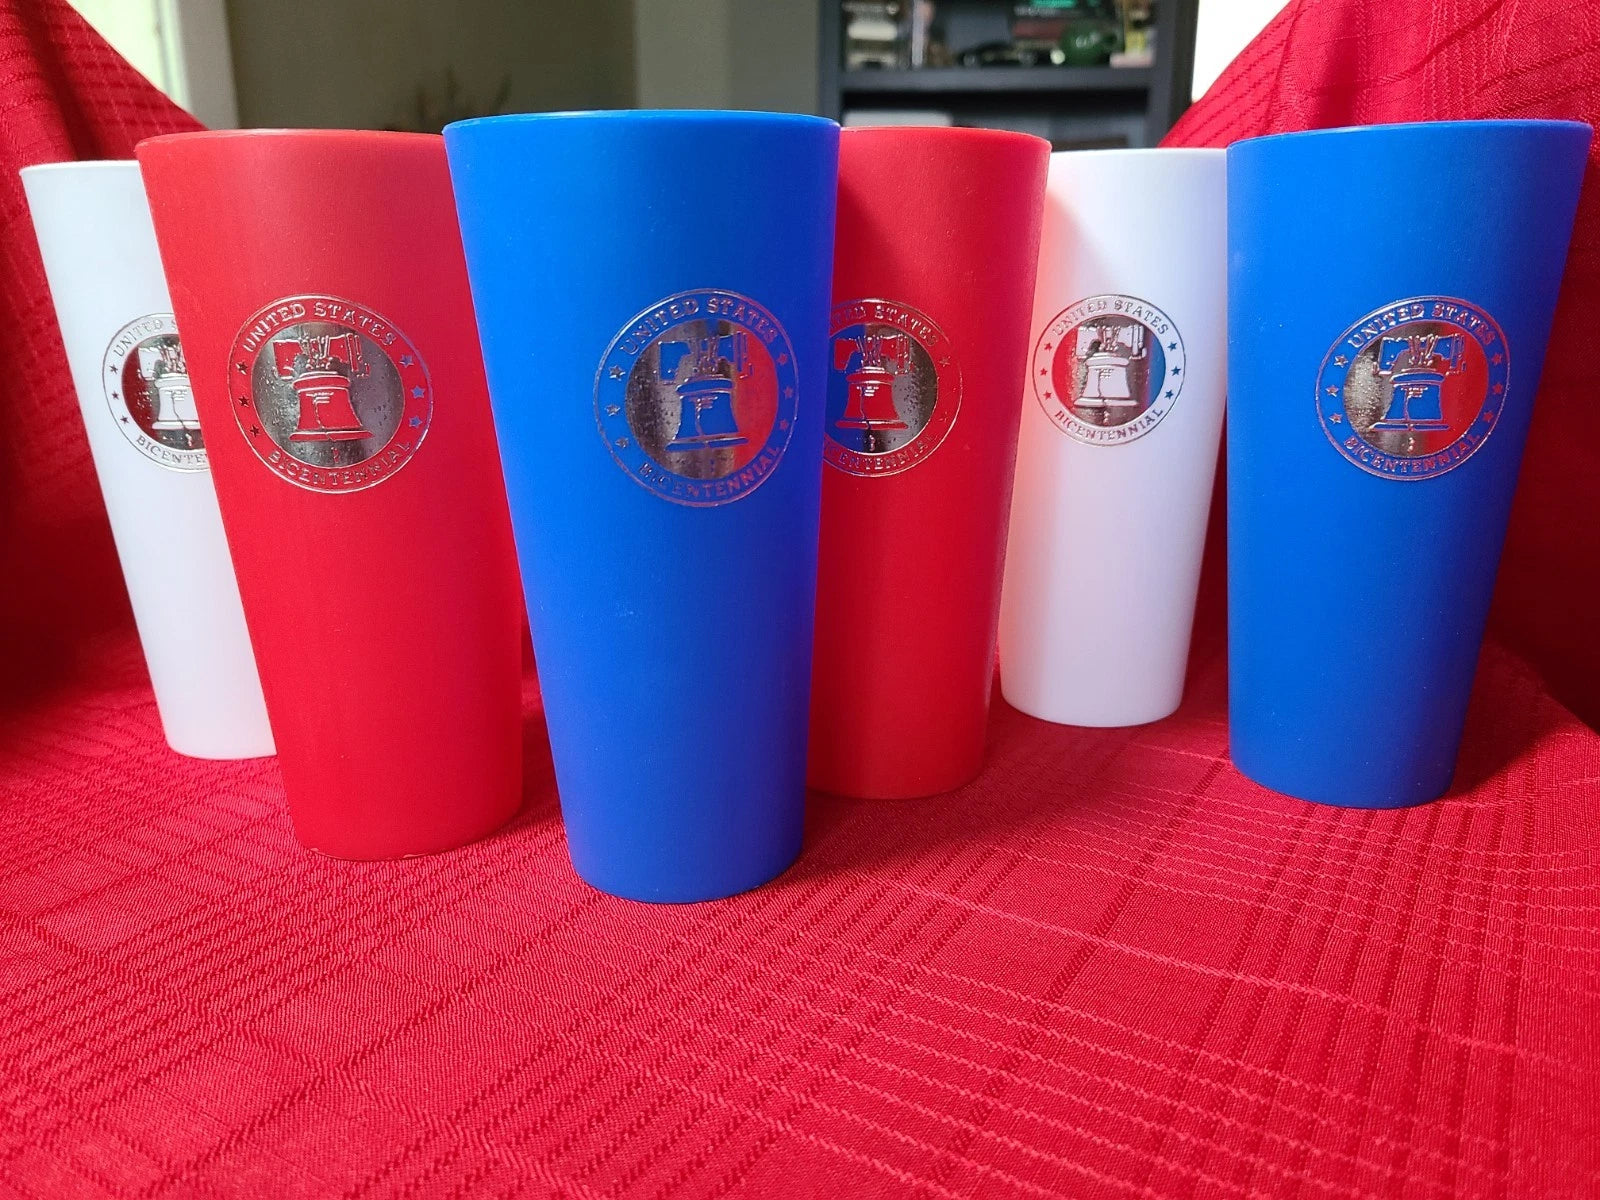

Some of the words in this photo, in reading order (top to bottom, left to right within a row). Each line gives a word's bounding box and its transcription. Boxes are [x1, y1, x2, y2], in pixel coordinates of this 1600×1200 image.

[114, 319, 164, 357] UNITED
[243, 303, 305, 352] UNITED
[315, 302, 397, 346] STATES
[620, 298, 699, 354] UNITED
[707, 298, 778, 344] STATES
[874, 305, 938, 346] STATES
[1053, 300, 1107, 336] UNITED
[1114, 300, 1170, 335] STATES
[1348, 303, 1425, 348] UNITED
[1432, 303, 1496, 345] STATES
[1054, 408, 1164, 440] BICENTENNIAL
[136, 434, 207, 464] BICENTE
[268, 441, 411, 486] BICENTENNIAL
[1344, 433, 1481, 473] BICENTENNIAL
[639, 446, 779, 497] BICENTENNIAL
